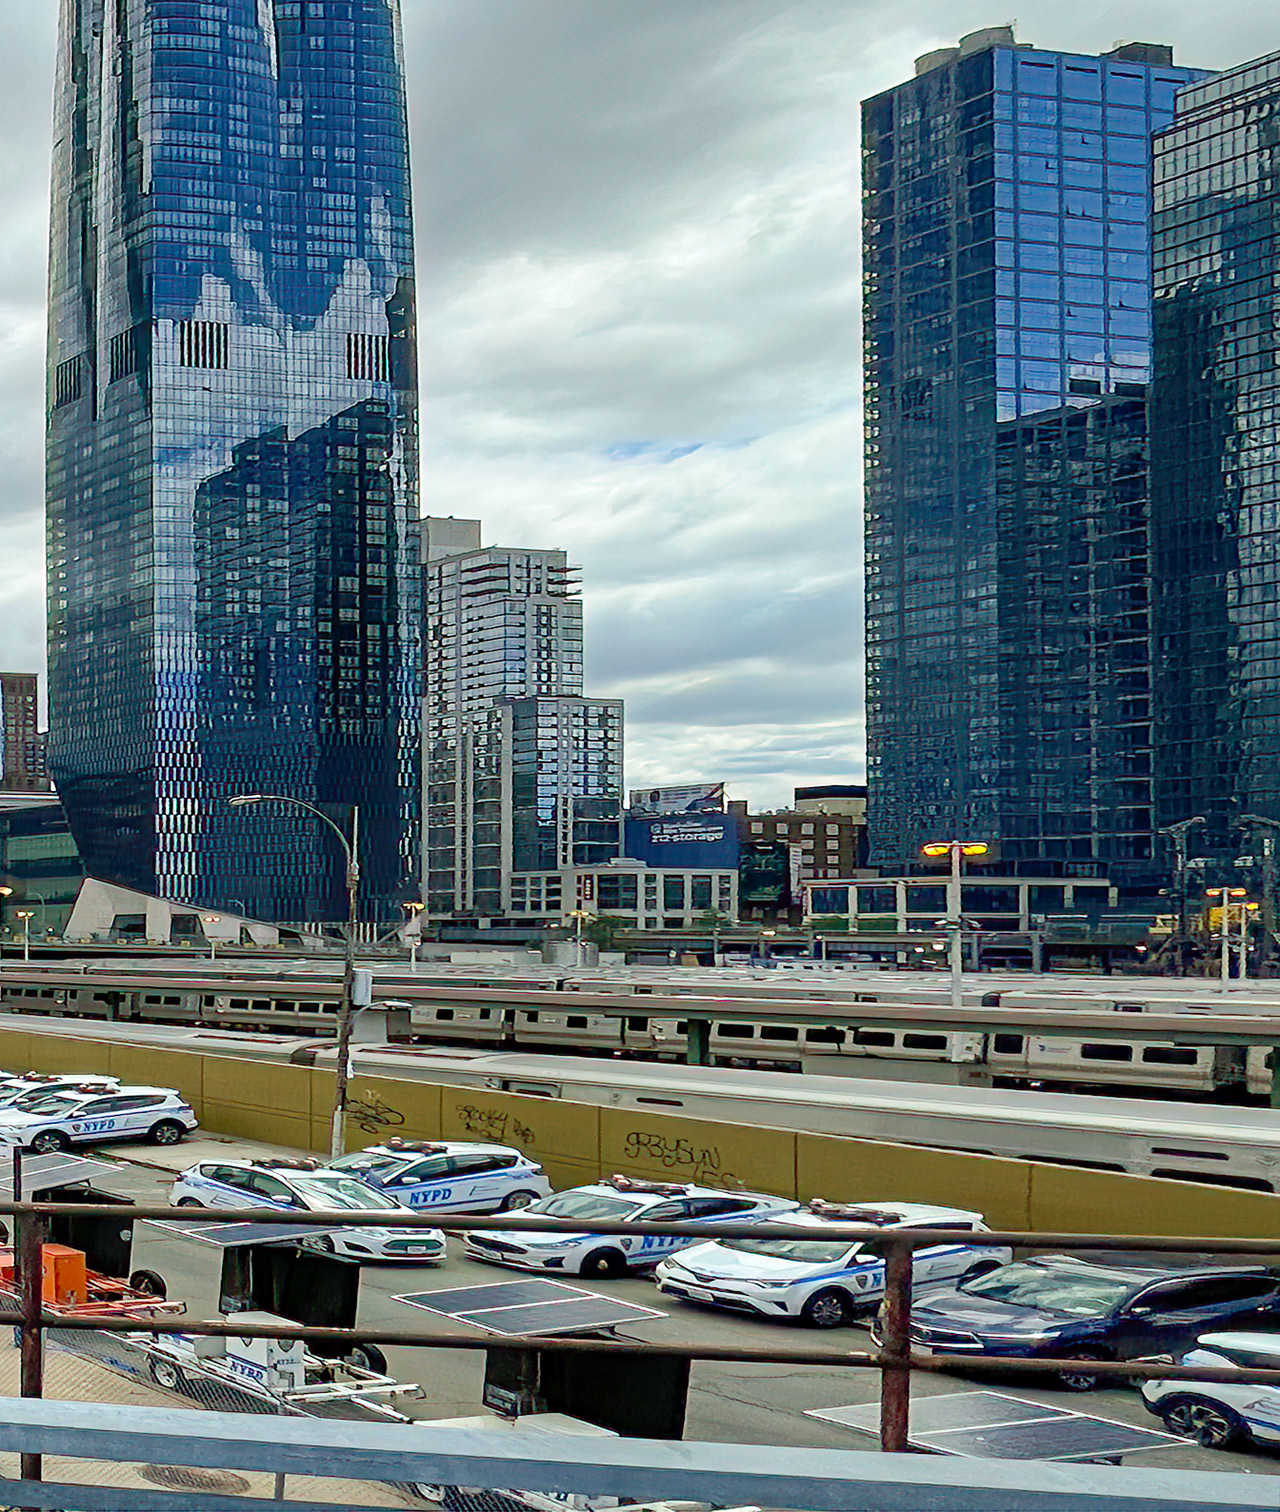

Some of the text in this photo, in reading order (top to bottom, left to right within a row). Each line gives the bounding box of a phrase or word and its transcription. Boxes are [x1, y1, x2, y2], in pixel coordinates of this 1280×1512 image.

[83, 1119, 116, 1132] NYPD
[410, 1188, 453, 1205] NYPD
[229, 1360, 264, 1380] NYPD
